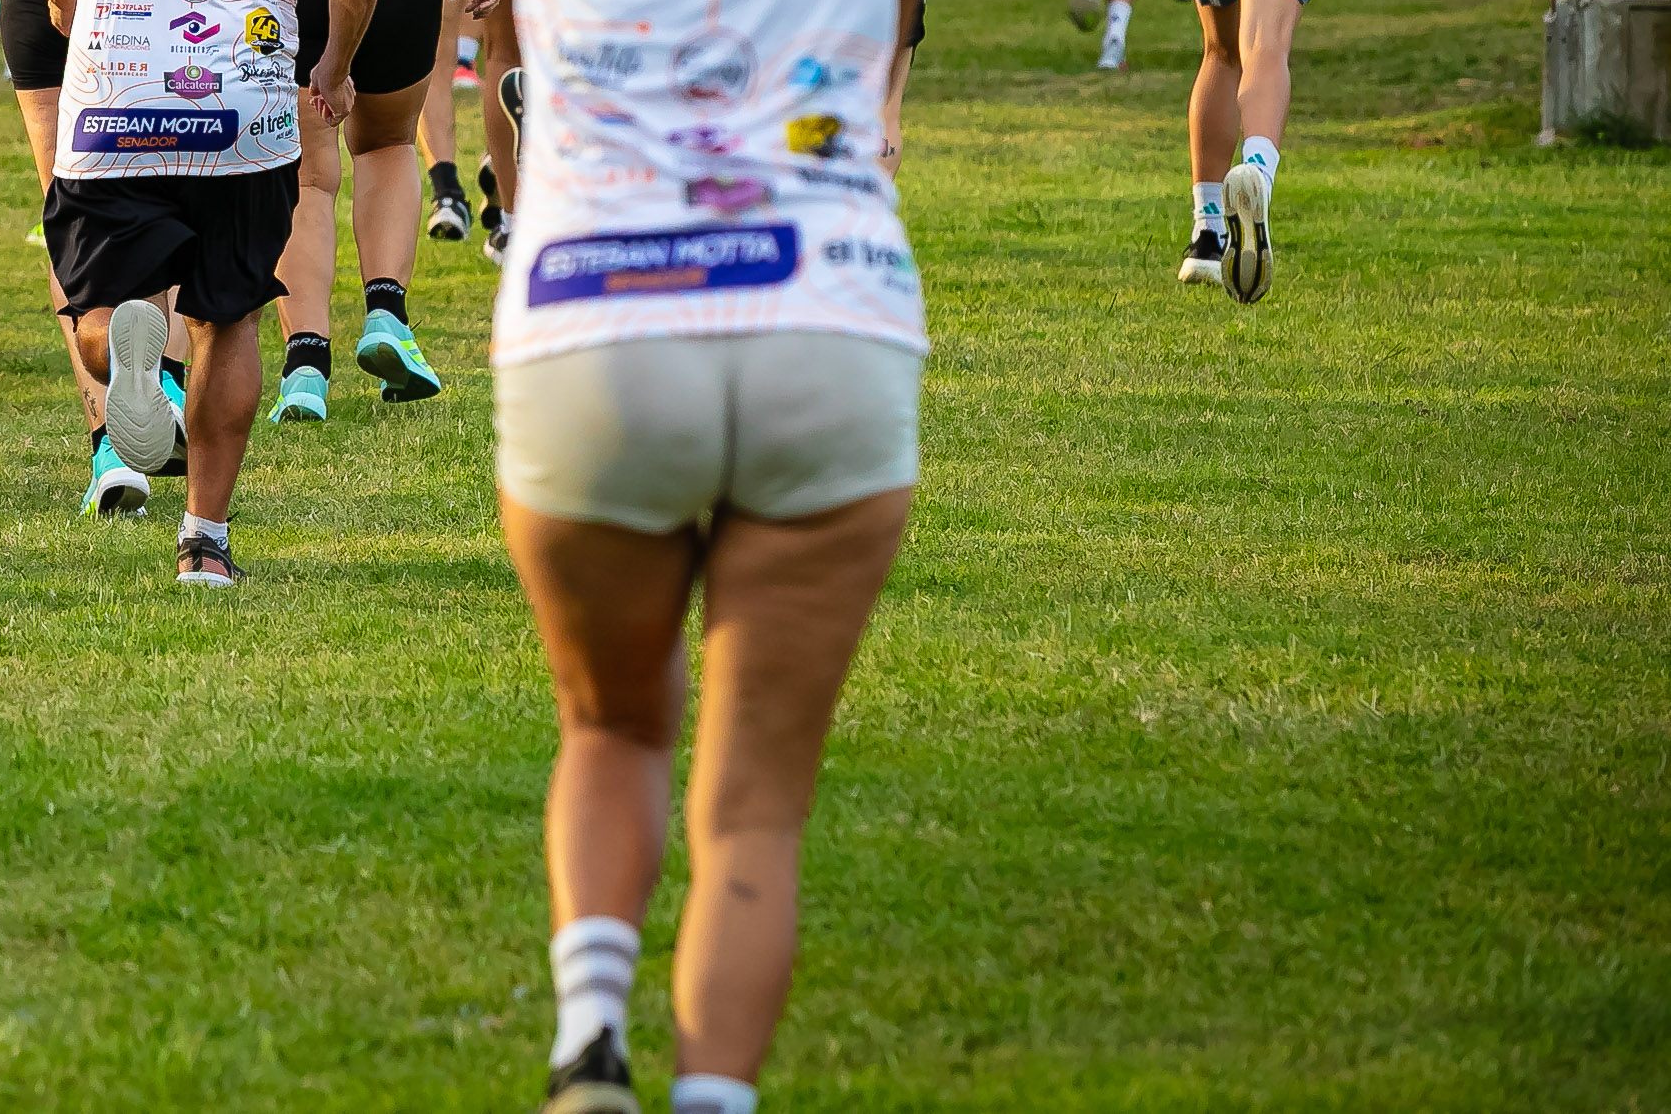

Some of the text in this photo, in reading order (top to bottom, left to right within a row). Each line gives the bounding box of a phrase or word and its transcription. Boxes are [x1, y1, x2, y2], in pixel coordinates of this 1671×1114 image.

[105, 34, 150, 46] MEDINA
[167, 79, 220, 90] Calcaterra
[82, 115, 223, 134] ESTEBAN MOTTA
[249, 116, 265, 136] el
[116, 136, 178, 148] SENADOR
